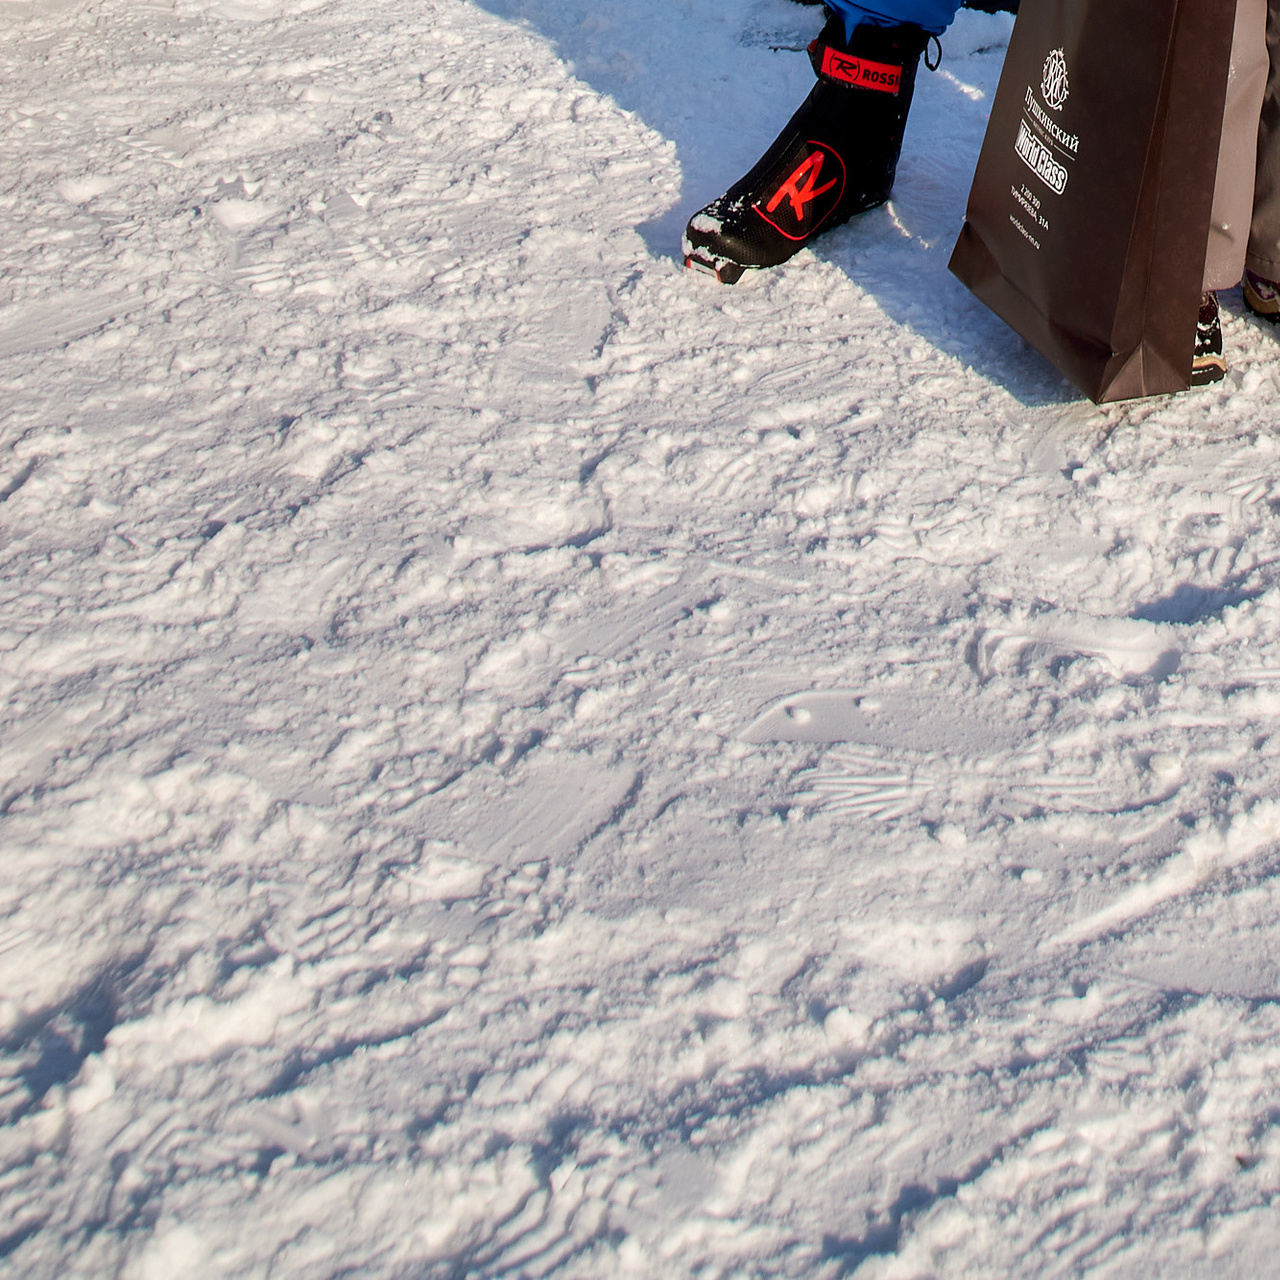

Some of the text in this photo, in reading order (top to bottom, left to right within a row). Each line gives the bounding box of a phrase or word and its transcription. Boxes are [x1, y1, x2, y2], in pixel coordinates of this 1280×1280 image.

[862, 68, 899, 87] ROSSI
[1024, 85, 1080, 153] Пушкинский
[1015, 123, 1041, 168] World
[1036, 149, 1066, 191] Class
